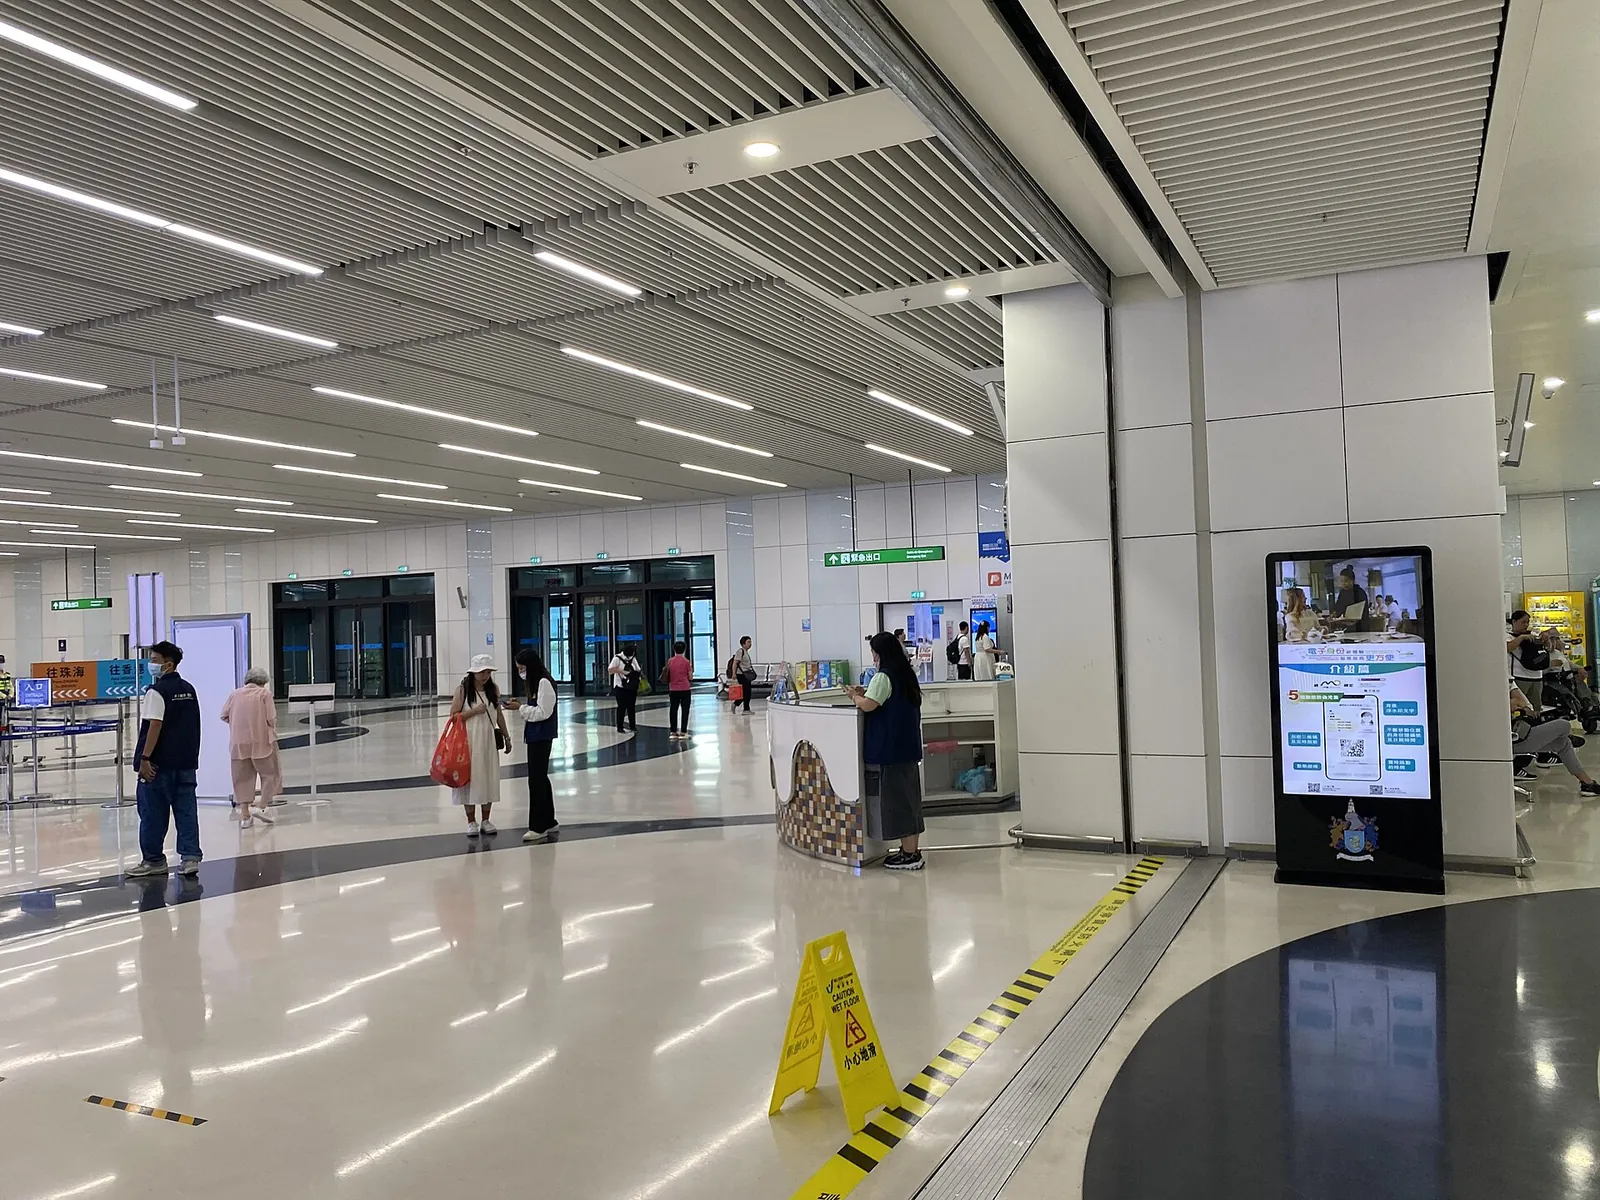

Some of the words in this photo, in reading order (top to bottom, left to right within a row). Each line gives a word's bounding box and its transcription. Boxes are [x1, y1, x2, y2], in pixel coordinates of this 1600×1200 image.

[851, 553, 880, 562] 緊急出口
[46, 666, 85, 678] 往珠海
[25, 683, 43, 691] 入口
[832, 987, 854, 1002] CAUTION
[831, 1003, 842, 1014] WET
[844, 995, 860, 1008] FLOOR
[845, 1042, 877, 1070] 小心地滑
